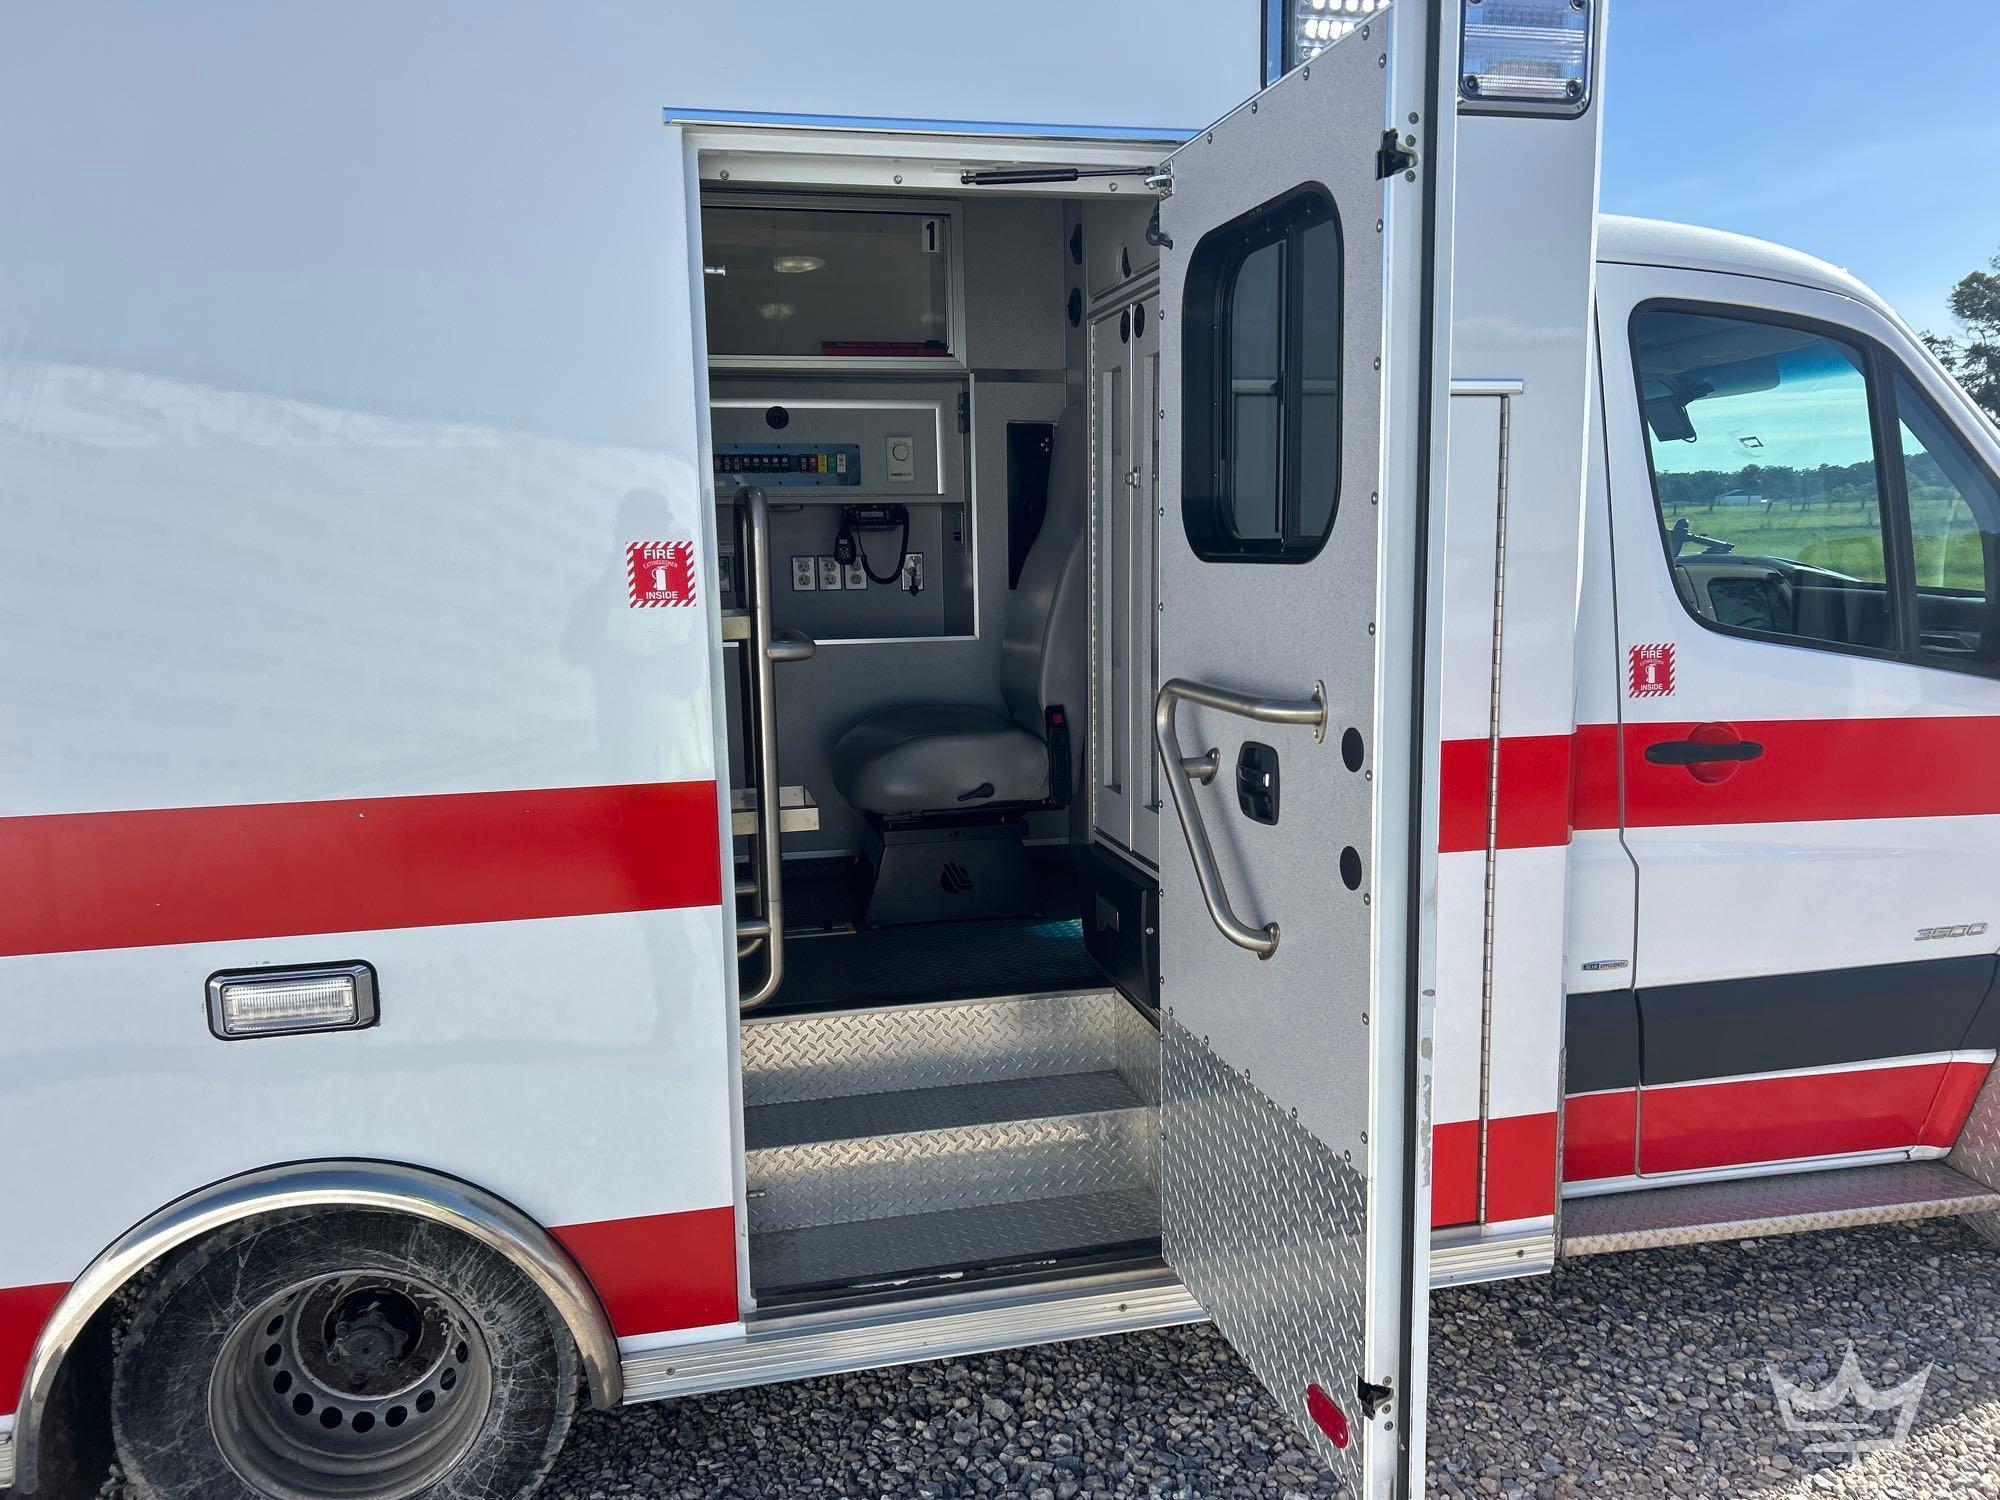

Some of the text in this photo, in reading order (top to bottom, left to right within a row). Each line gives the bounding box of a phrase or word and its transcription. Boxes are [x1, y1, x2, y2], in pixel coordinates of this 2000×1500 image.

[643, 549, 676, 560] FIRE
[645, 591, 679, 600] INSIDE
[1640, 650, 1663, 659] FIRE
[1640, 683, 1664, 691] INSIDE
[1914, 923, 1988, 941] 3500
